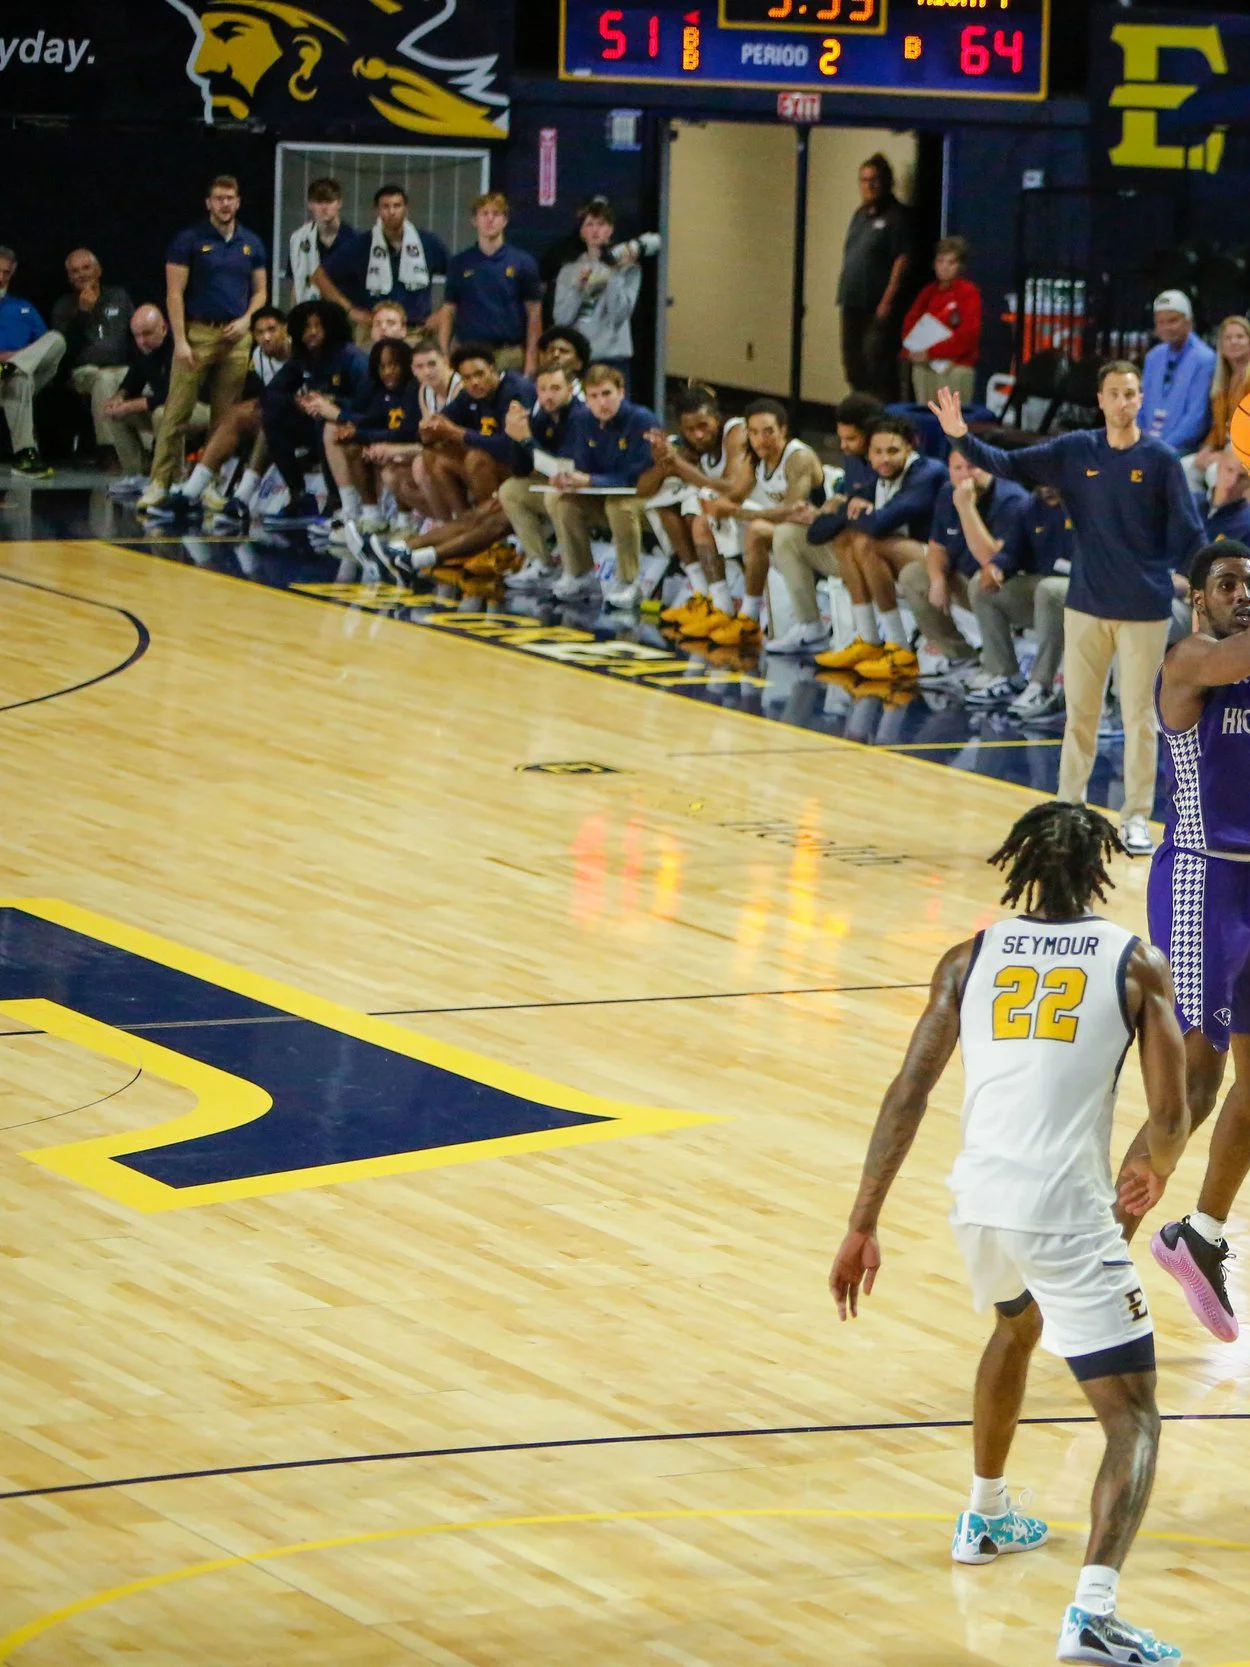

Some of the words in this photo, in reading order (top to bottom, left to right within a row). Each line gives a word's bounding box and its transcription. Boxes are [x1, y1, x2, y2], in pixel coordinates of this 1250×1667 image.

[599, 10, 660, 59] 51
[741, 42, 809, 67] PERIOD
[818, 38, 841, 76] 2
[960, 25, 1024, 75] 64
[1002, 935, 1100, 956] SEYMOUR
[992, 965, 1089, 1043] 22
